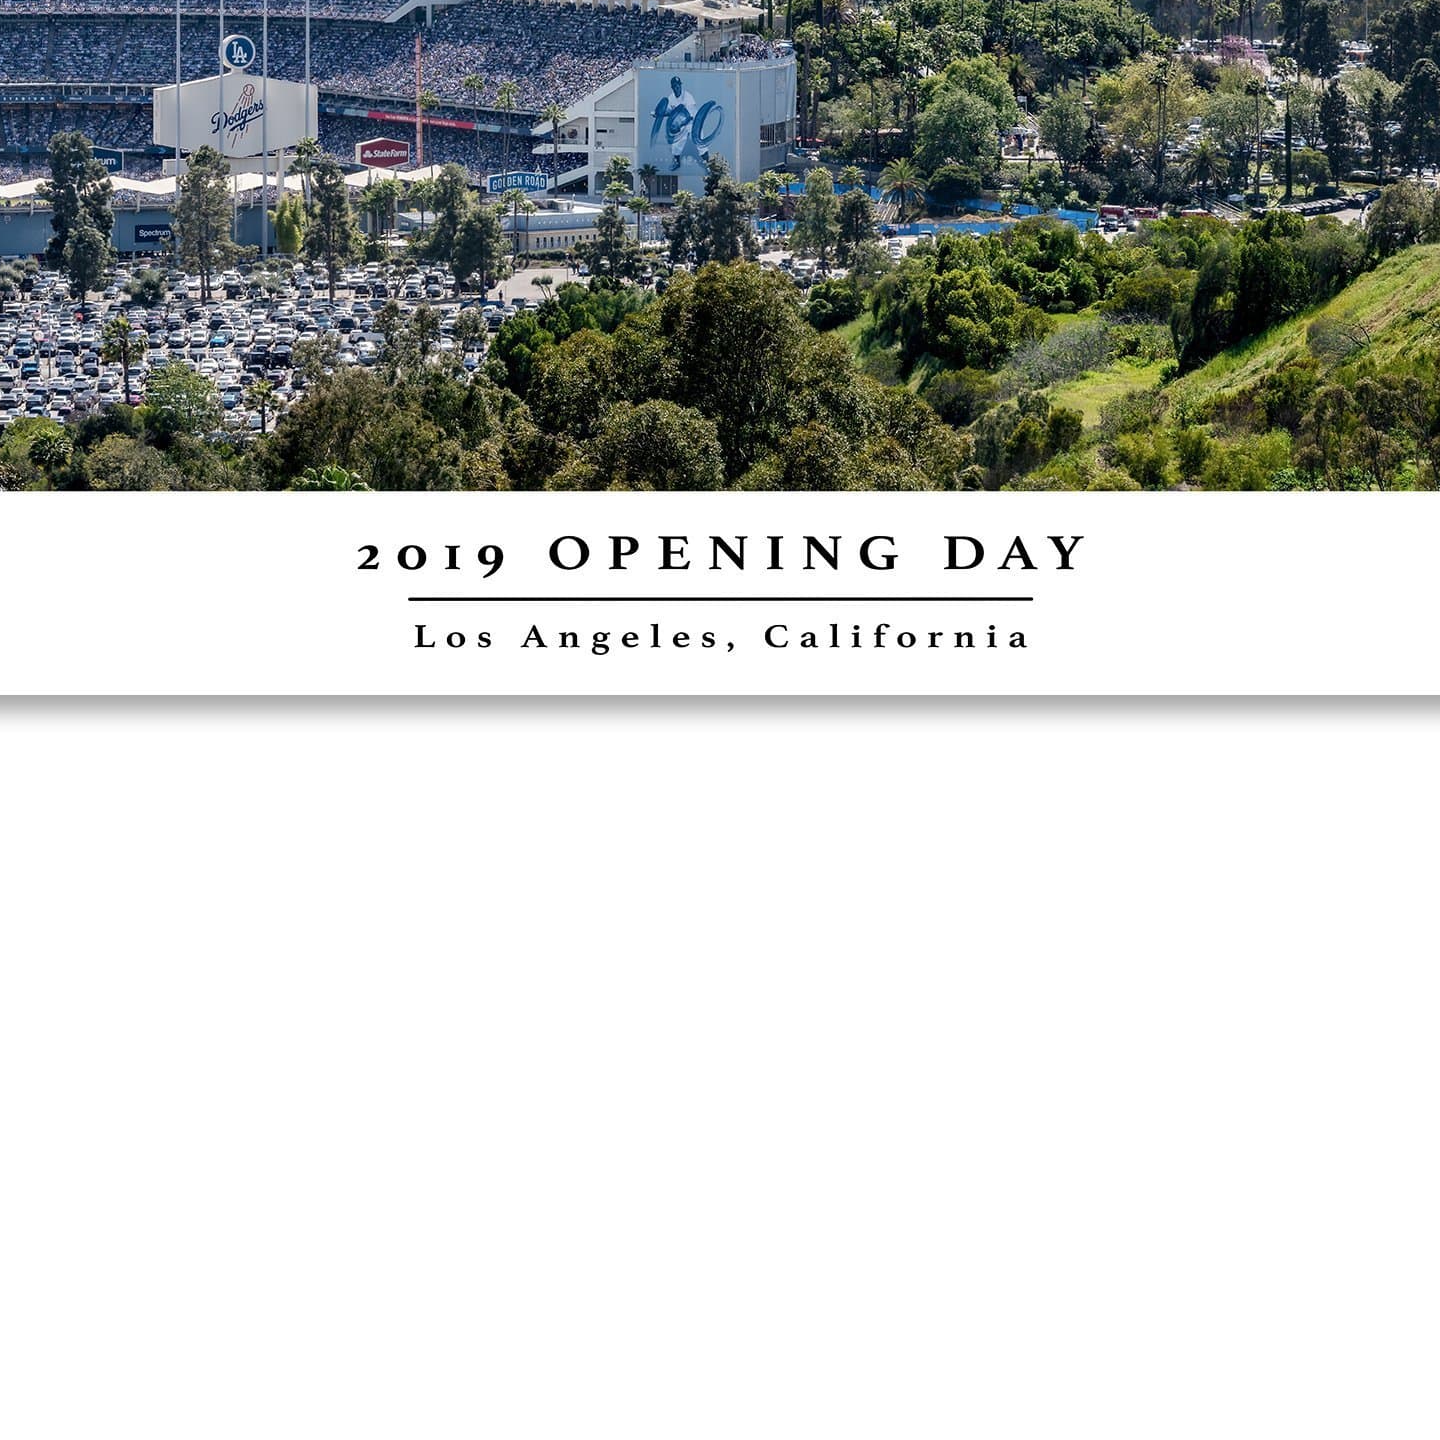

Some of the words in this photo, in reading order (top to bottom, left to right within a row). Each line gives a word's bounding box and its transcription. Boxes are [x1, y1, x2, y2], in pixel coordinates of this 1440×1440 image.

[231, 41, 247, 64] LA
[211, 99, 265, 134] Dodgers
[492, 174, 523, 191] GOLDEN
[524, 174, 546, 188] ROAD
[138, 228, 171, 238] Spectrum
[357, 544, 504, 579] 2019
[548, 535, 899, 571] OPENING
[943, 535, 1085, 571] DAY
[413, 624, 492, 649] Los
[519, 623, 735, 656] Angeles,
[764, 623, 1028, 649] California
